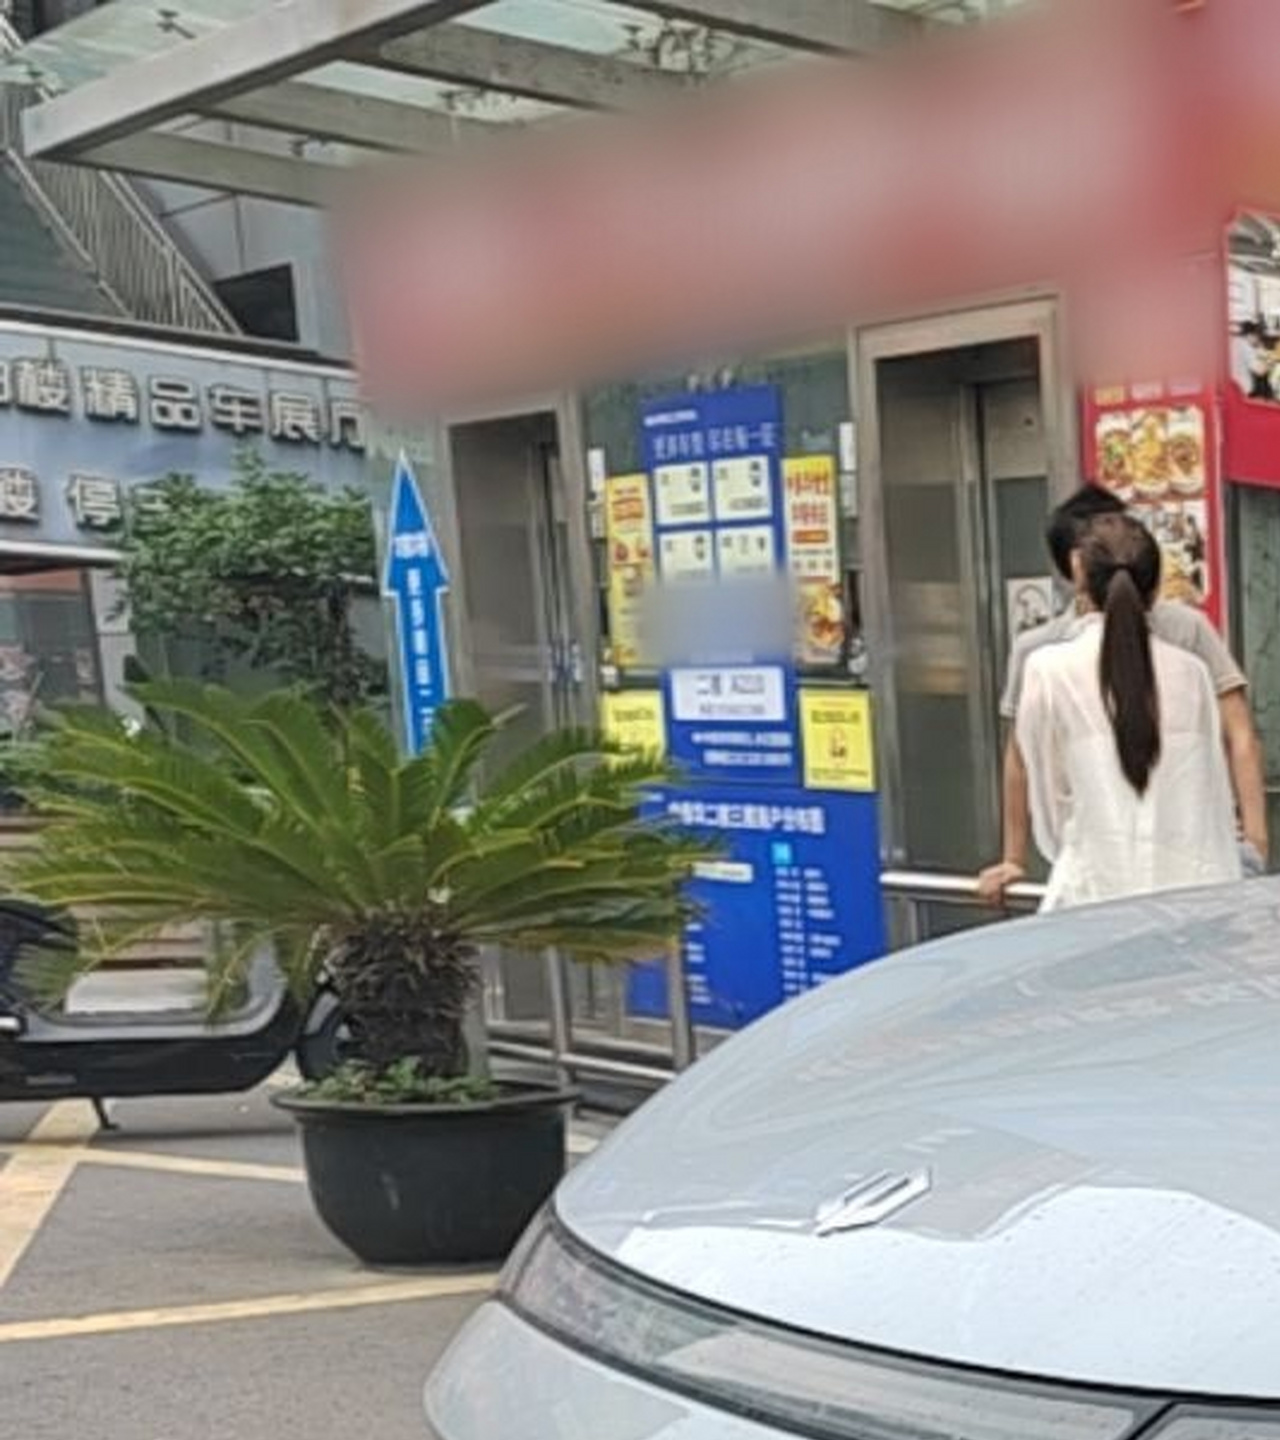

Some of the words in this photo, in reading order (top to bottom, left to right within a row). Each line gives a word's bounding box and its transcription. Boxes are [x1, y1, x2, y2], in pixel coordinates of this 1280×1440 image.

[0, 357, 366, 450] 楼精品车展厅
